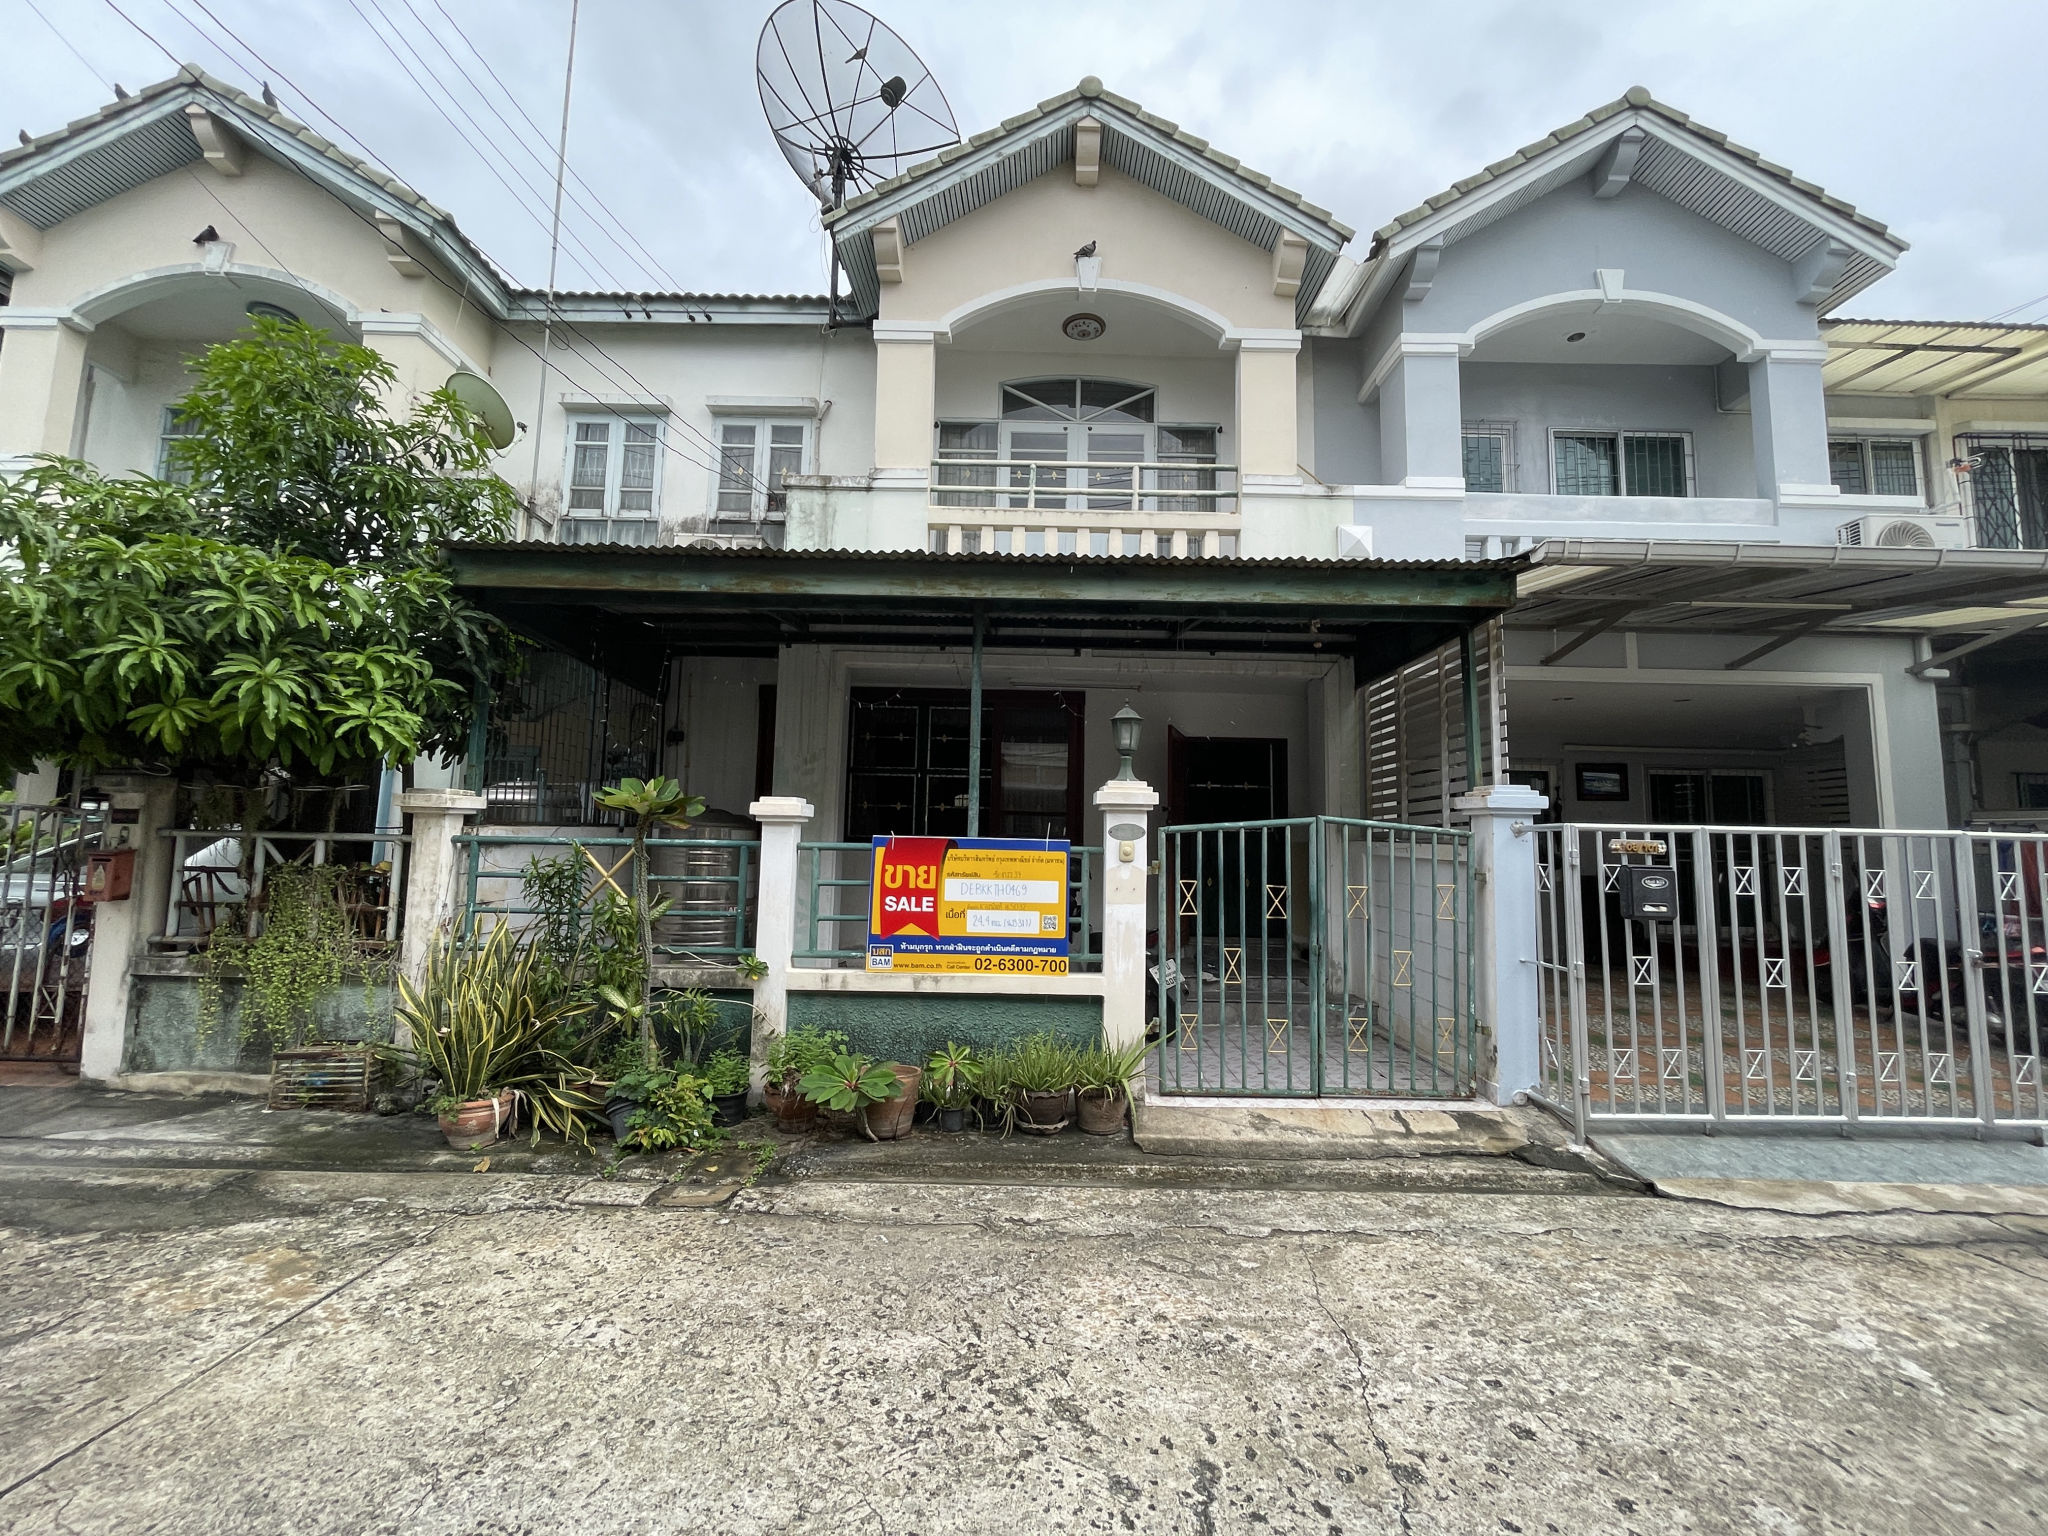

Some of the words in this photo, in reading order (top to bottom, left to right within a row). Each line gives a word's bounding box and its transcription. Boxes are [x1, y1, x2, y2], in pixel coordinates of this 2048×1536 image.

[884, 864, 936, 889] ขาย
[884, 896, 934, 912] SALE
[945, 908, 966, 919] เนื้อที่
[872, 947, 892, 956] บสก
[900, 942, 933, 952] ห้ามบุกรุก
[871, 957, 891, 966] BAM
[974, 957, 1067, 973] 02-6300-700
